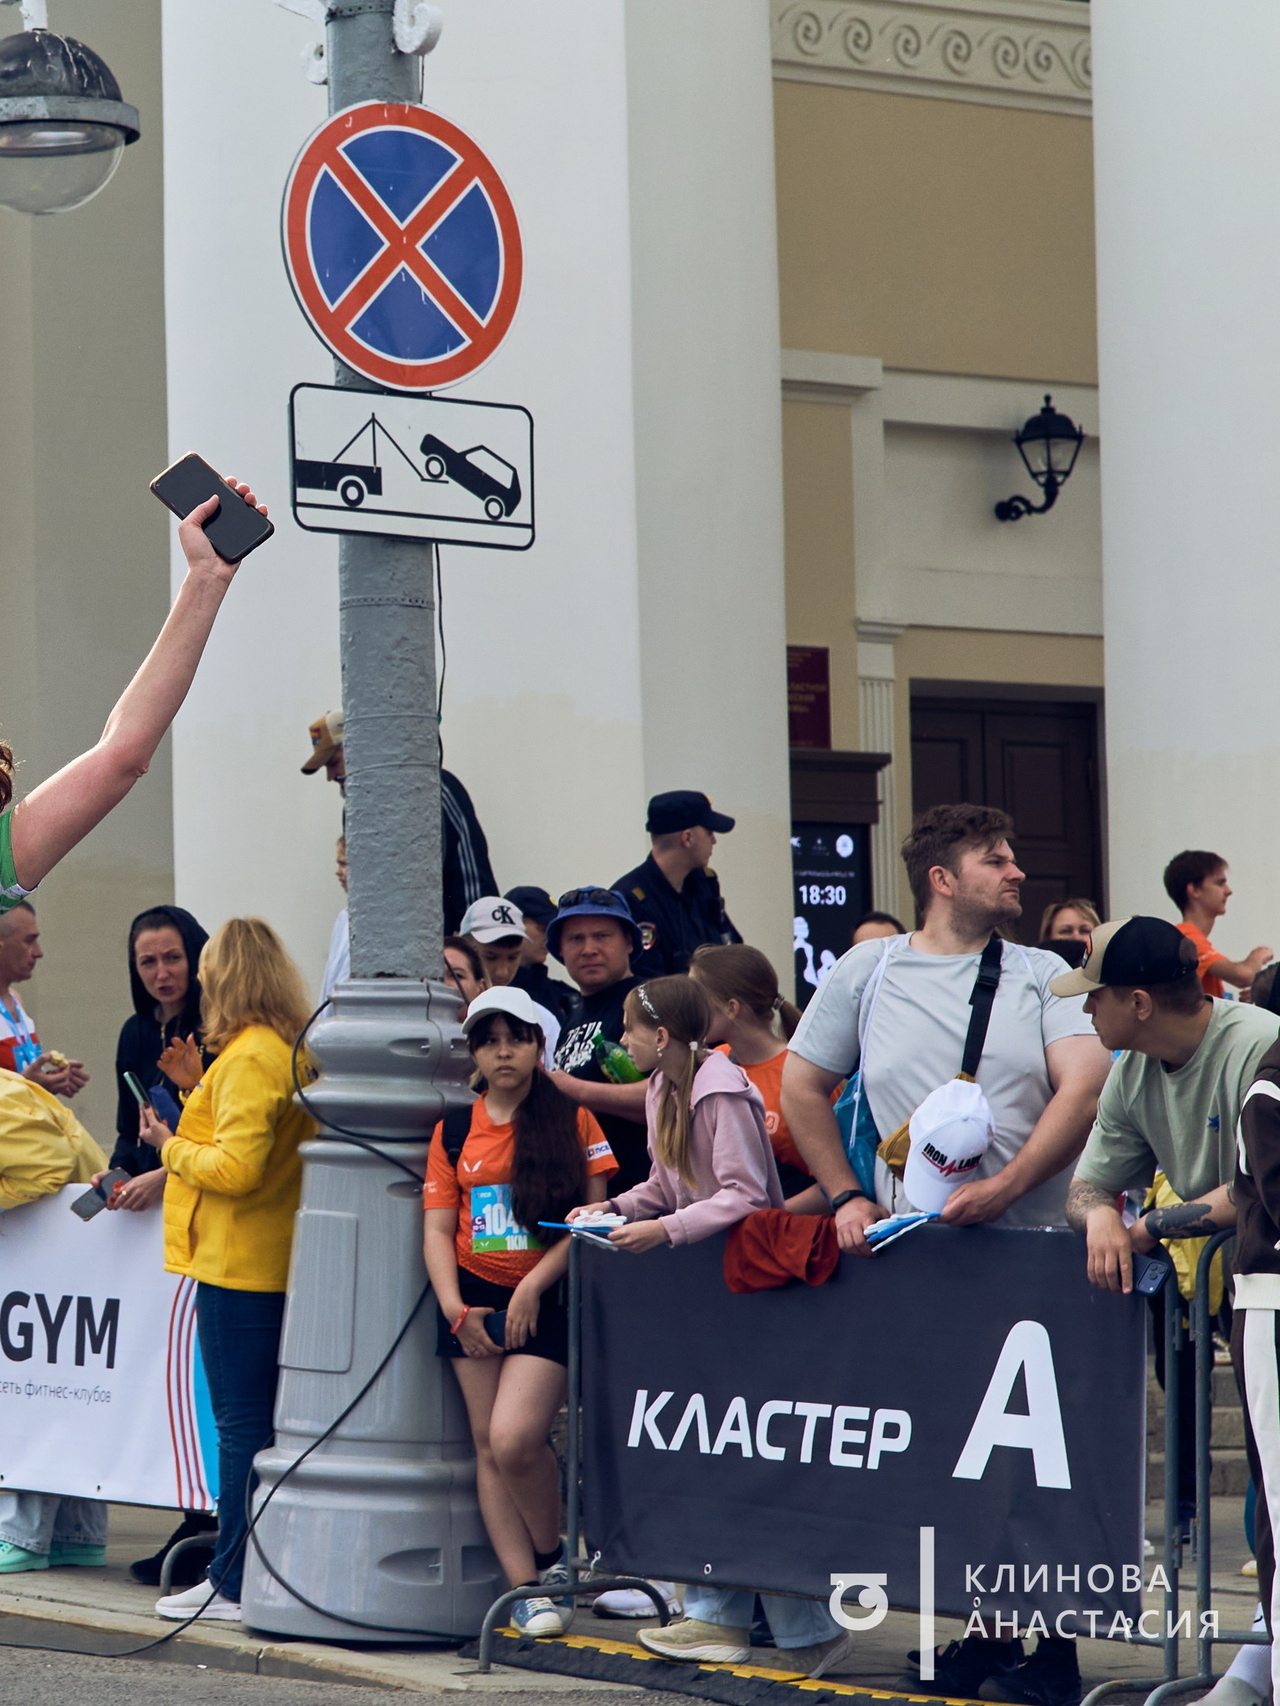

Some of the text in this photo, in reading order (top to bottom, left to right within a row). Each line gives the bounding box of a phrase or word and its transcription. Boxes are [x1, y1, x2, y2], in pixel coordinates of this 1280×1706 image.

[799, 885, 847, 906] 18:30
[923, 1142, 948, 1167] IRON
[0, 1290, 121, 1370] GYM
[24, 1379, 112, 1406] фитнес-клубов
[627, 1389, 913, 1471] КЛАСТЕР
